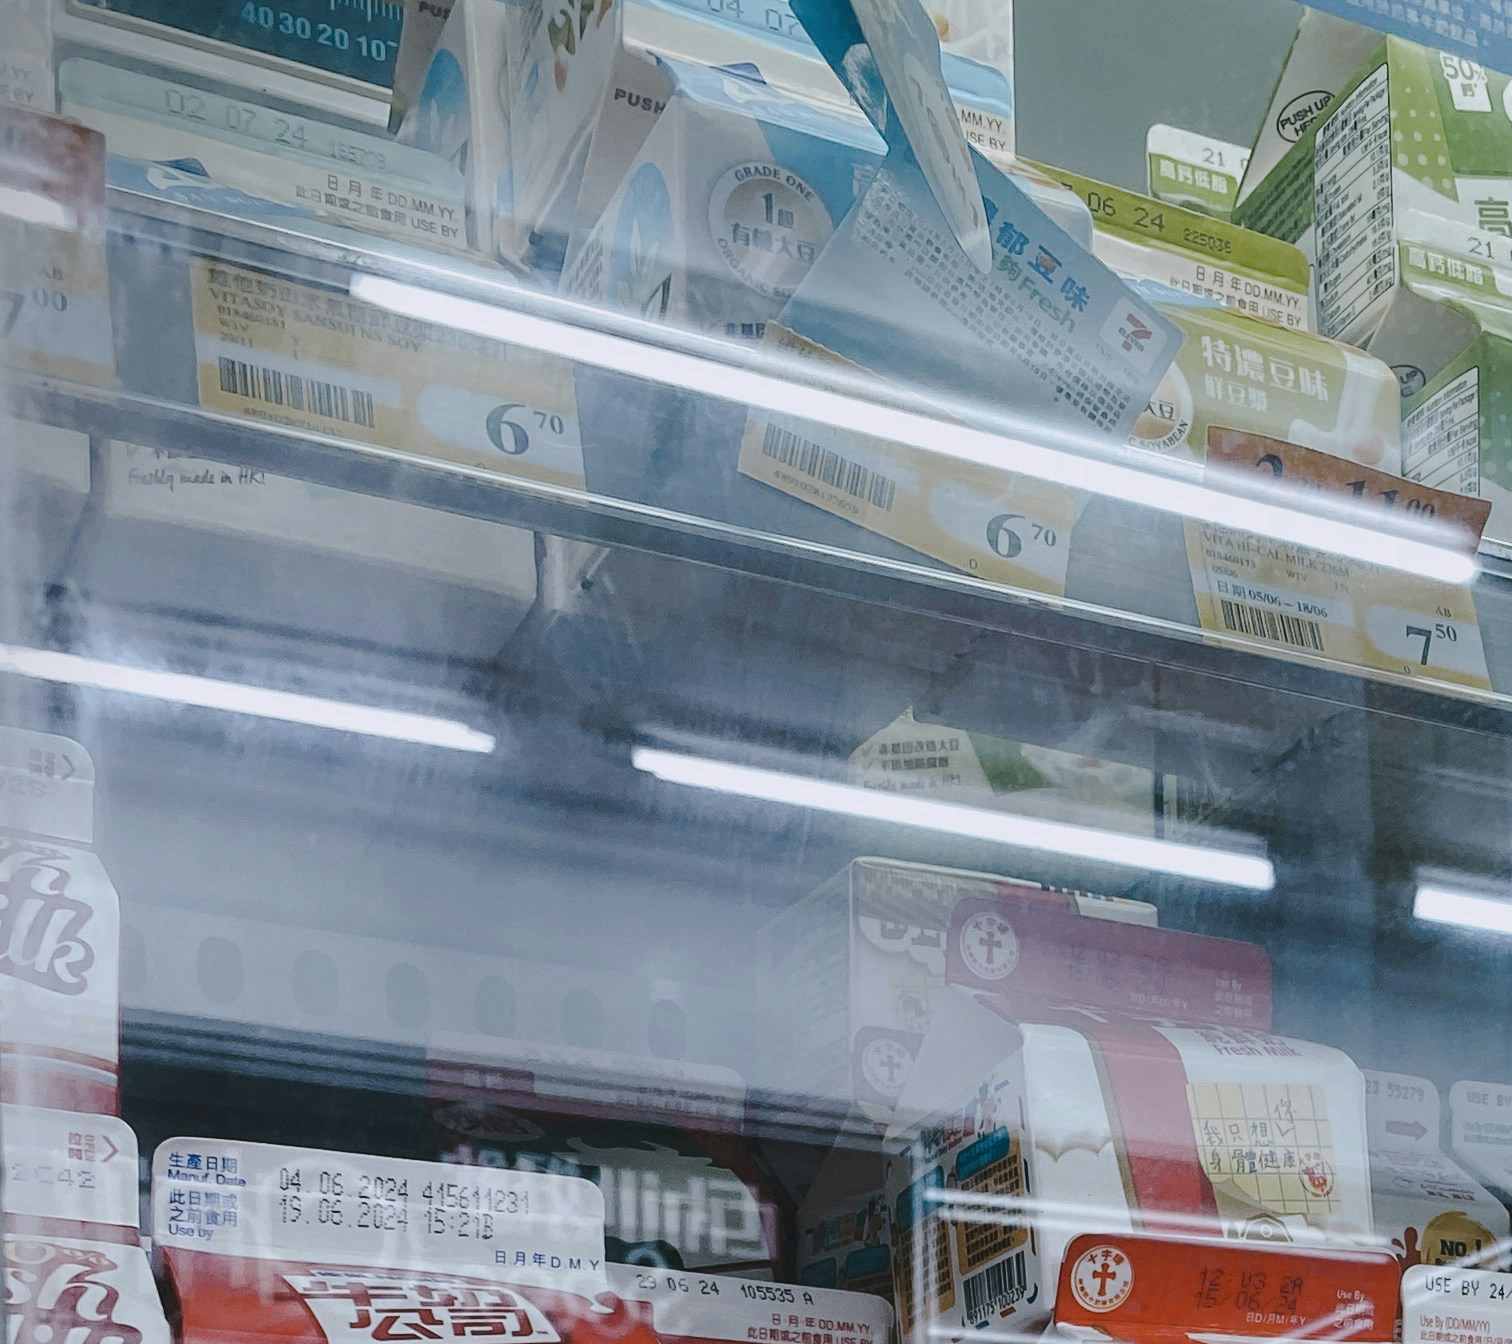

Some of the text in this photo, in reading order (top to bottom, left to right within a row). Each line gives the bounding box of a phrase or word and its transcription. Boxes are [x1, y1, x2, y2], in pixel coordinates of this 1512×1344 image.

[279, 11, 311, 35] 30
[318, 23, 350, 50] 20
[1134, 207, 1165, 232] 24
[1468, 236, 1494, 260] 21
[1202, 334, 1330, 403] 特濃豆味
[486, 403, 530, 455] 6
[986, 514, 1028, 558] 6
[1406, 625, 1433, 665] 7
[1425, 1275, 1452, 1293] USE
[1461, 1280, 1481, 1297] BY
